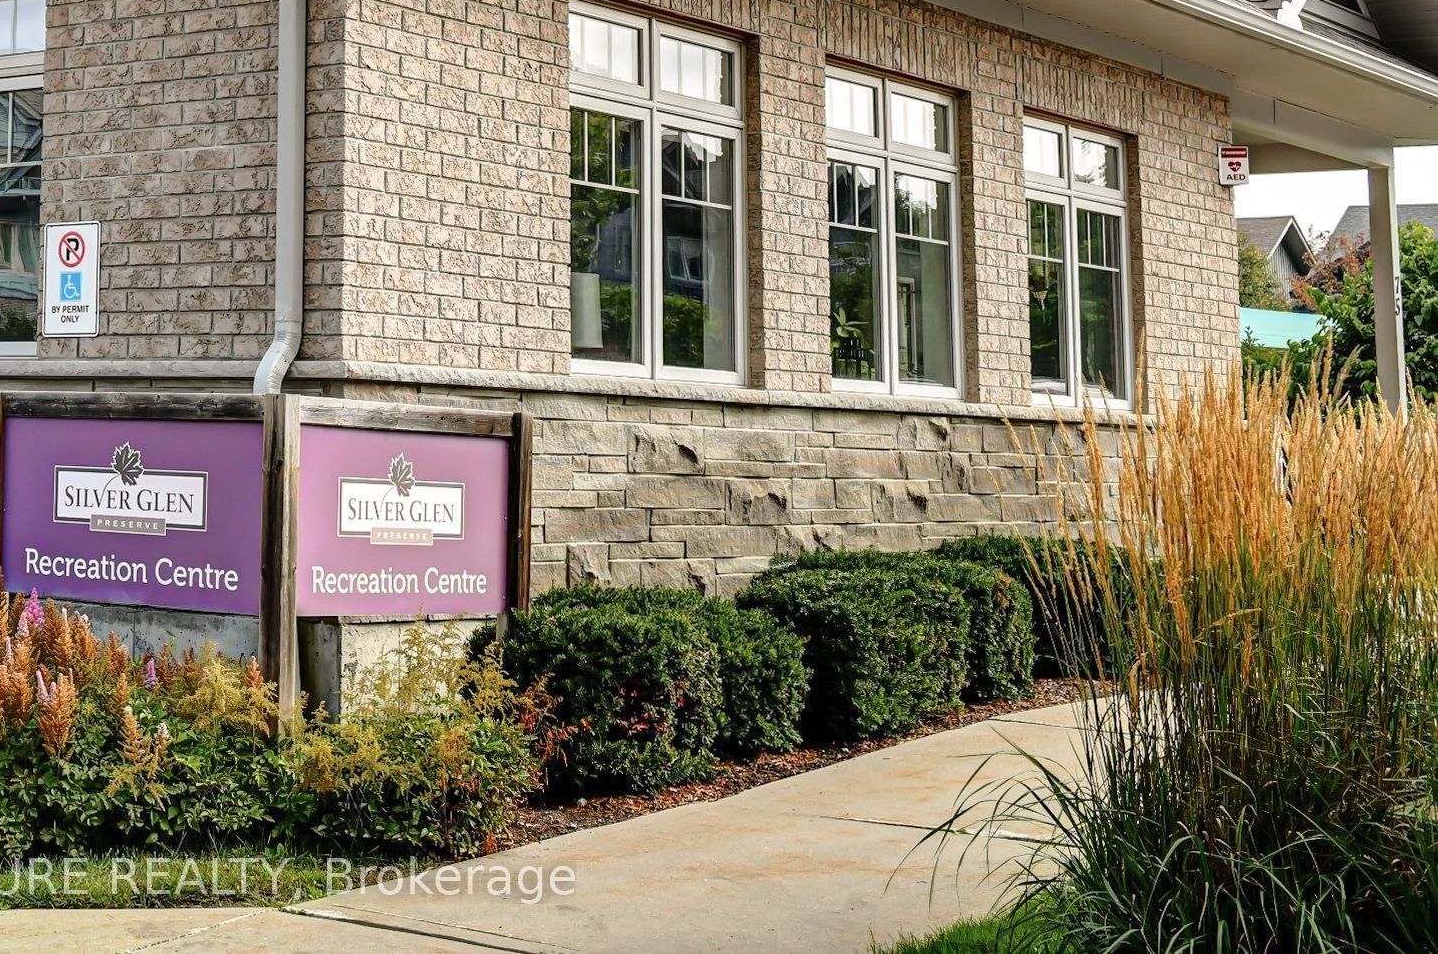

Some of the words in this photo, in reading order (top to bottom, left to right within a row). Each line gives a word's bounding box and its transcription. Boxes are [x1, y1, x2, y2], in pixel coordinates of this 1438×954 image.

[1226, 173, 1246, 181] AED
[1394, 276, 1401, 316] 75
[51, 305, 60, 314] BY
[62, 304, 89, 314] PERMIT
[60, 315, 80, 323] ONLY
[64, 485, 130, 510] SILVER
[136, 489, 194, 513] GLEN
[348, 498, 405, 521] SILVER
[409, 500, 454, 523] GLEN
[97, 518, 158, 530] PRESERVE
[376, 531, 428, 541] PRESERVE
[25, 548, 147, 583] Recreation
[155, 557, 239, 591] Centre
[312, 565, 419, 594] Recreation
[425, 566, 487, 594] Centre
